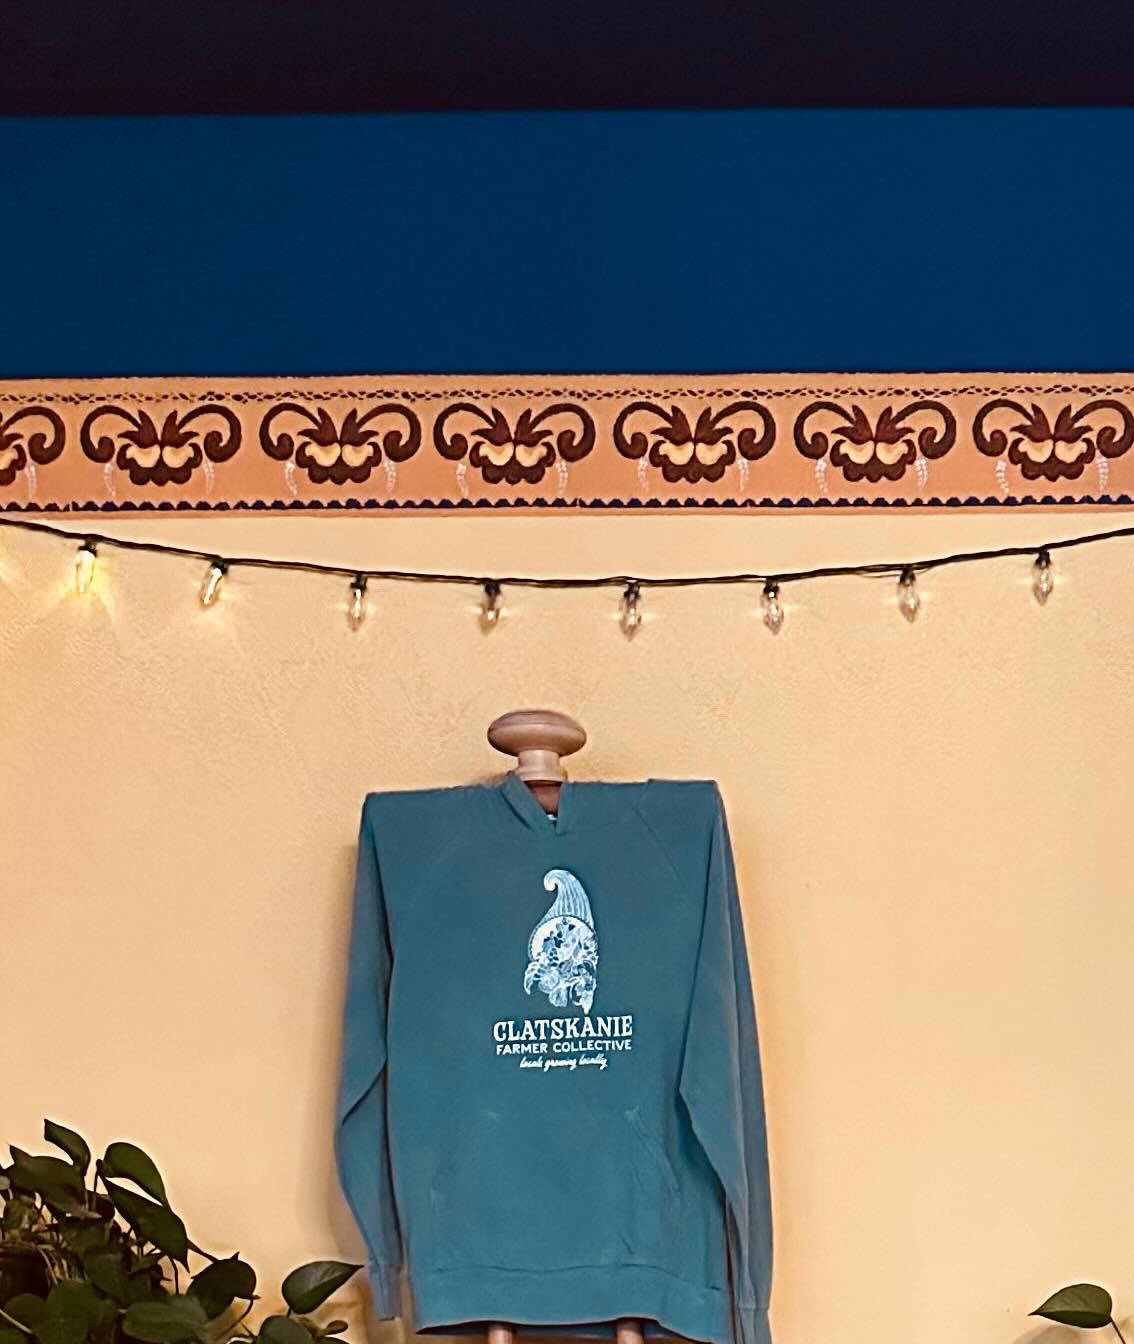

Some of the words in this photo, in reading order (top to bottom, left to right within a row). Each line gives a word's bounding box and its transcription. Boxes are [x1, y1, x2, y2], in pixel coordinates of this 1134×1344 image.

[493, 1015, 633, 1042] CLATSKANIE
[496, 1043, 548, 1056] FARMER
[553, 1039, 632, 1053] COLLECTIVE
